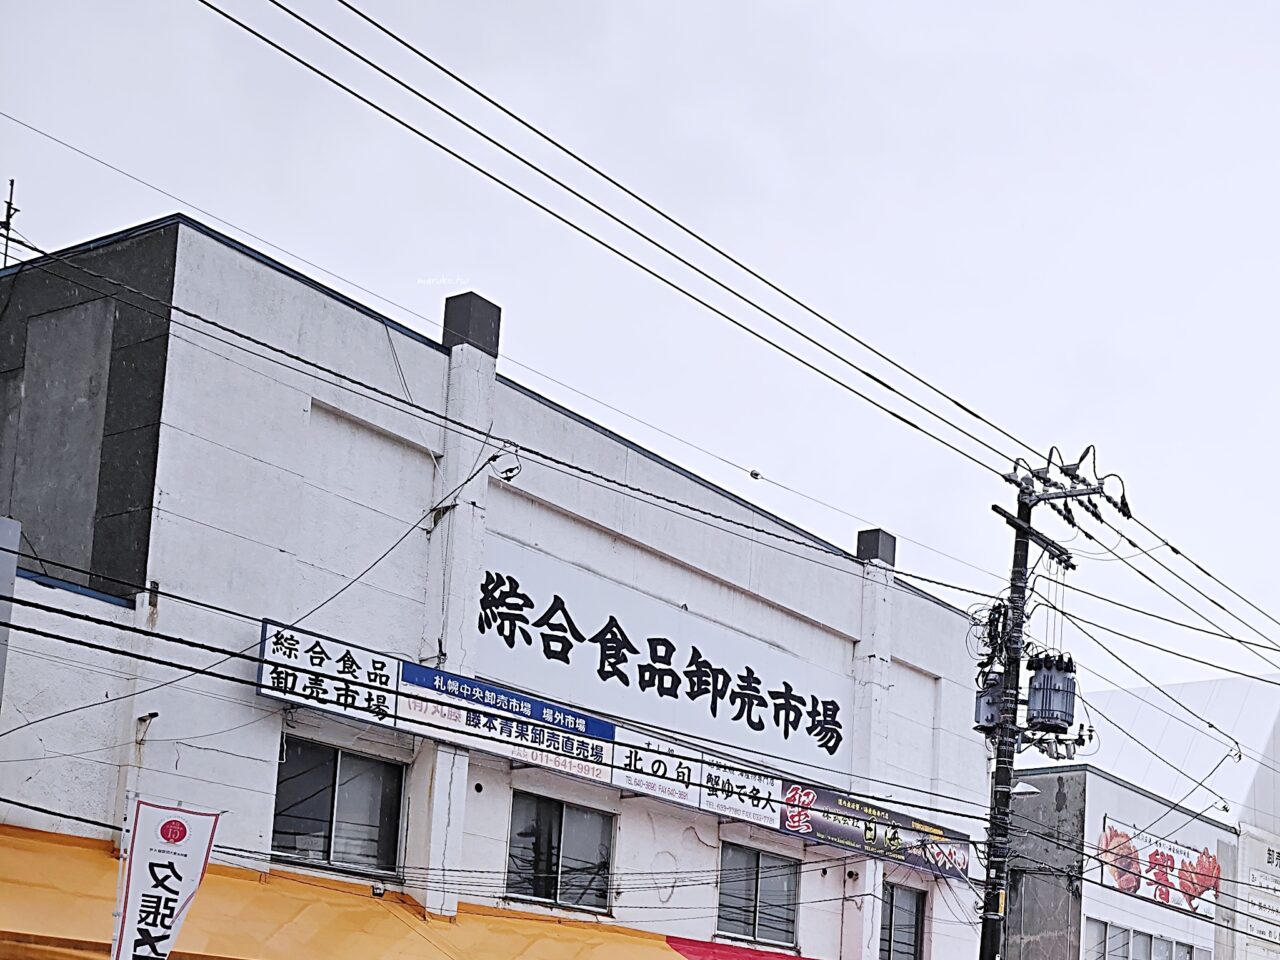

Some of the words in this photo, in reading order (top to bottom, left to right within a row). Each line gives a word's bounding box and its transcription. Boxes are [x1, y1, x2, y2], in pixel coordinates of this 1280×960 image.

[271, 629, 391, 688] 綜合食品
[477, 570, 844, 756] 綜合食品卸売市場
[269, 665, 388, 723] 卸売市場
[433, 674, 532, 717] 札幌中央卸売市場
[541, 705, 587, 734] 場外市場
[464, 711, 604, 763] 藤本青果卸売直売場
[530, 750, 602, 779] 011-641-9912
[624, 748, 692, 790] 北の旬
[705, 772, 777, 814] 蟹ゆで名人
